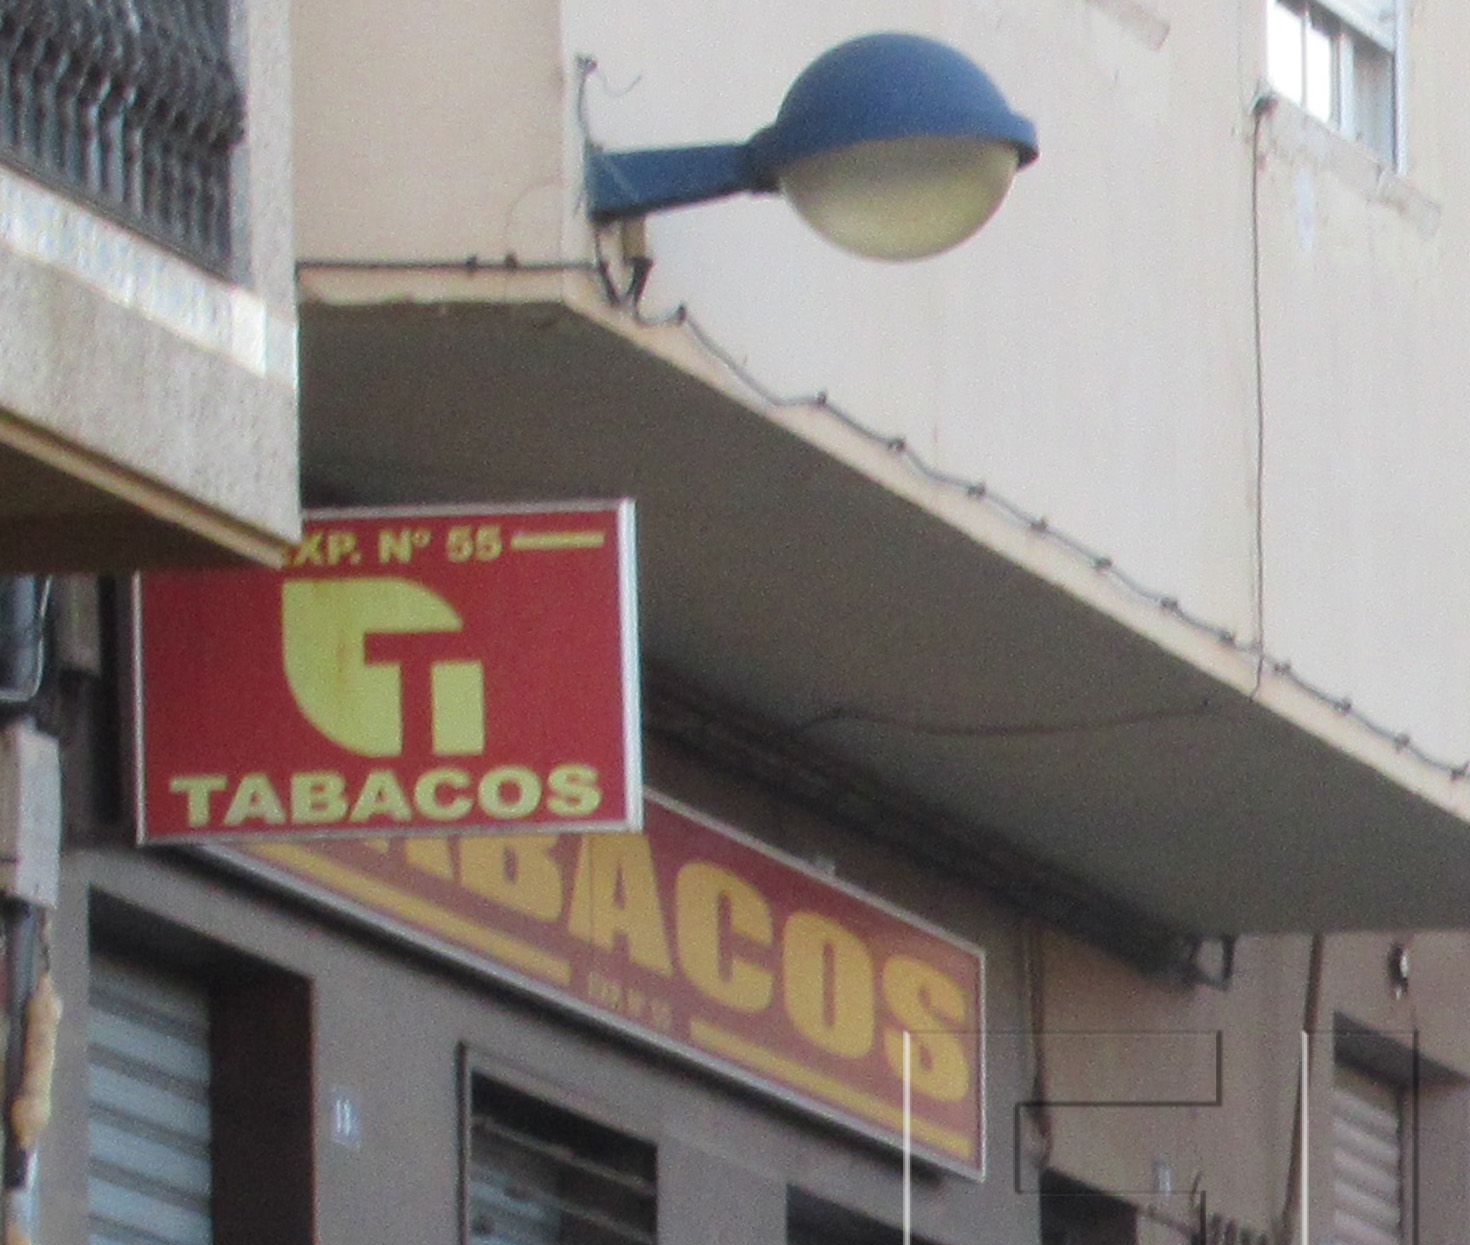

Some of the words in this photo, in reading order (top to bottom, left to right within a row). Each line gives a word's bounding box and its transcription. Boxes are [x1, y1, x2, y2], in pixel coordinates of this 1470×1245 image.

[286, 526, 363, 566] XP.
[446, 522, 503, 562] 55
[168, 763, 602, 828] TABACOS
[360, 833, 971, 1102] BACOS
